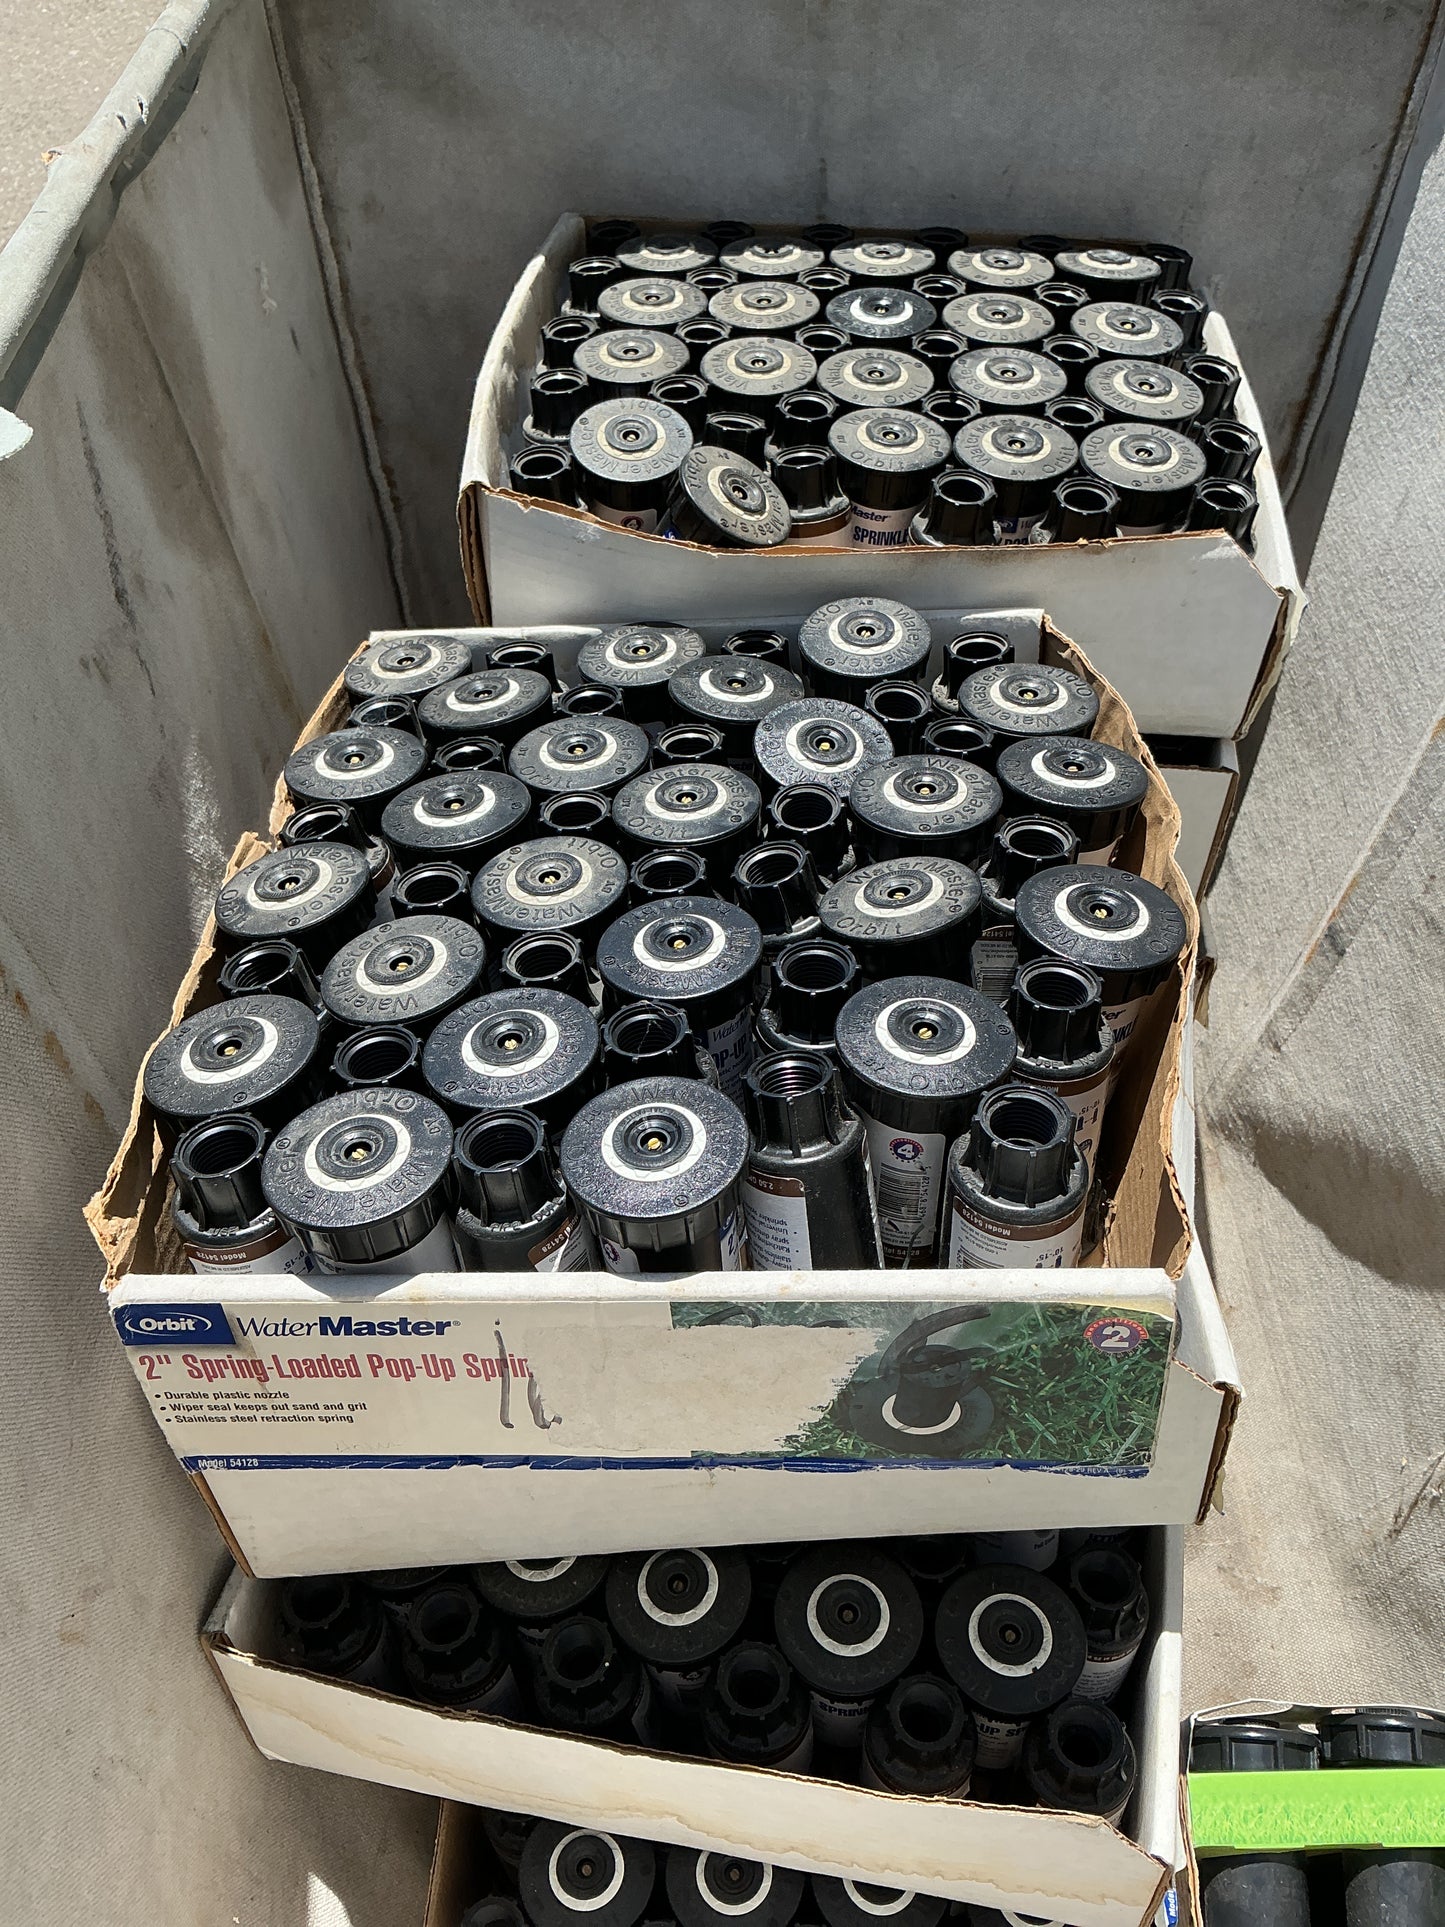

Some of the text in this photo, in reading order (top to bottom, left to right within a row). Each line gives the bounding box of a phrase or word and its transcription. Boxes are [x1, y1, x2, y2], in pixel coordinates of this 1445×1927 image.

[962, 1208, 1011, 1237] Model 54128
[541, 1233, 565, 1254] 54128
[220, 1251, 247, 1261] Model
[139, 1317, 197, 1331] Orbit
[1101, 1325, 1131, 1347] 2
[138, 1355, 172, 1380] 2"
[182, 1353, 361, 1383] Spring-Loaded
[366, 1353, 457, 1382] Pop-Up
[164, 1391, 290, 1402] Durable plastic nozzle
[169, 1402, 368, 1413] Wiper seal keeps out sand and grit
[174, 1414, 354, 1425] Stainless steel retraction spring
[198, 1457, 259, 1469] Model 54128
